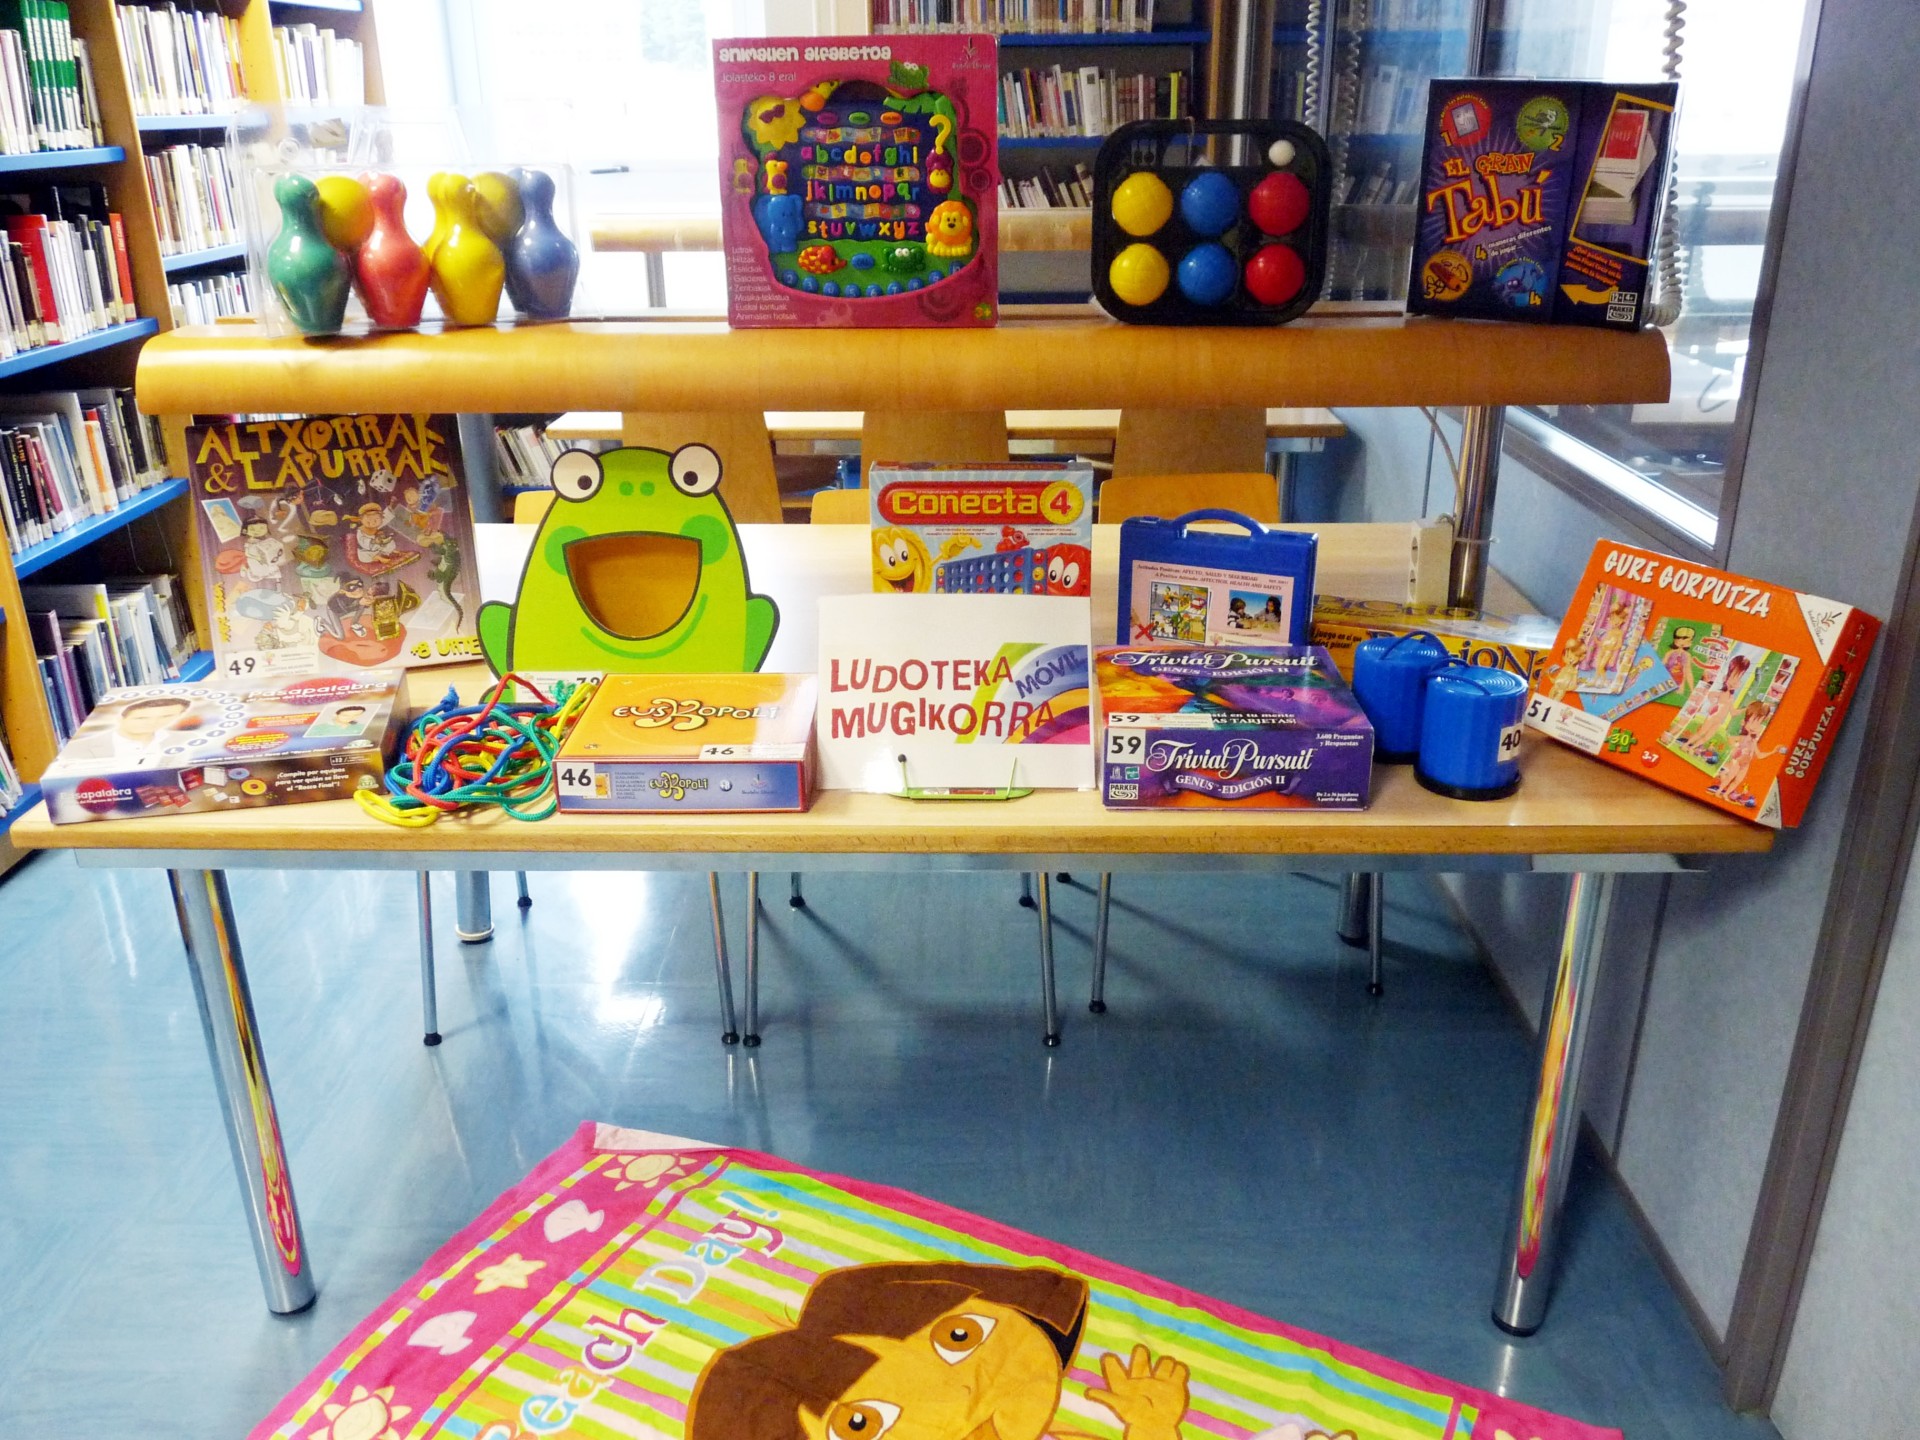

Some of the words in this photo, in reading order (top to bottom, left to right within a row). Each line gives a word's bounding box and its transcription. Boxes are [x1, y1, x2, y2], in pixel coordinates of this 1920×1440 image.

[770, 73, 775, 82] 8
[1549, 134, 1564, 152] 2
[1443, 158, 1471, 177] EL
[1475, 152, 1535, 175] GRAN
[1427, 170, 1552, 244] Tabú
[196, 412, 445, 466] ALTXORRAK
[204, 463, 238, 493] &
[240, 442, 448, 490] LAPURRAK
[892, 487, 1037, 515] Conecta
[1049, 489, 1072, 516] 4
[1604, 550, 1659, 584] GURE
[1658, 565, 1772, 618] GORPUTZA
[229, 657, 256, 676] 49
[1111, 651, 1214, 667] Trivial
[1204, 651, 1318, 669] Pursuit
[831, 656, 1014, 693] LUDOTEKA
[248, 682, 388, 699] Pasapalabra
[831, 698, 1058, 739] MUGIKORRA
[1111, 715, 1140, 723] 59
[1527, 700, 1551, 722] 51
[1111, 735, 1141, 755] 59
[1500, 729, 1522, 751] 40
[1609, 733, 1629, 747] 30
[1795, 705, 1836, 778] GORPUTZA
[705, 747, 735, 756] 46
[1146, 740, 1231, 772] Trivial
[1218, 739, 1314, 779] Pursuit
[1642, 751, 1659, 763] 3-7
[1785, 737, 1809, 775] GURE
[561, 768, 592, 787] 46
[1175, 775, 1214, 790] GENUS
[1275, 775, 1286, 785] II
[632, 1190, 785, 1304] Day!
